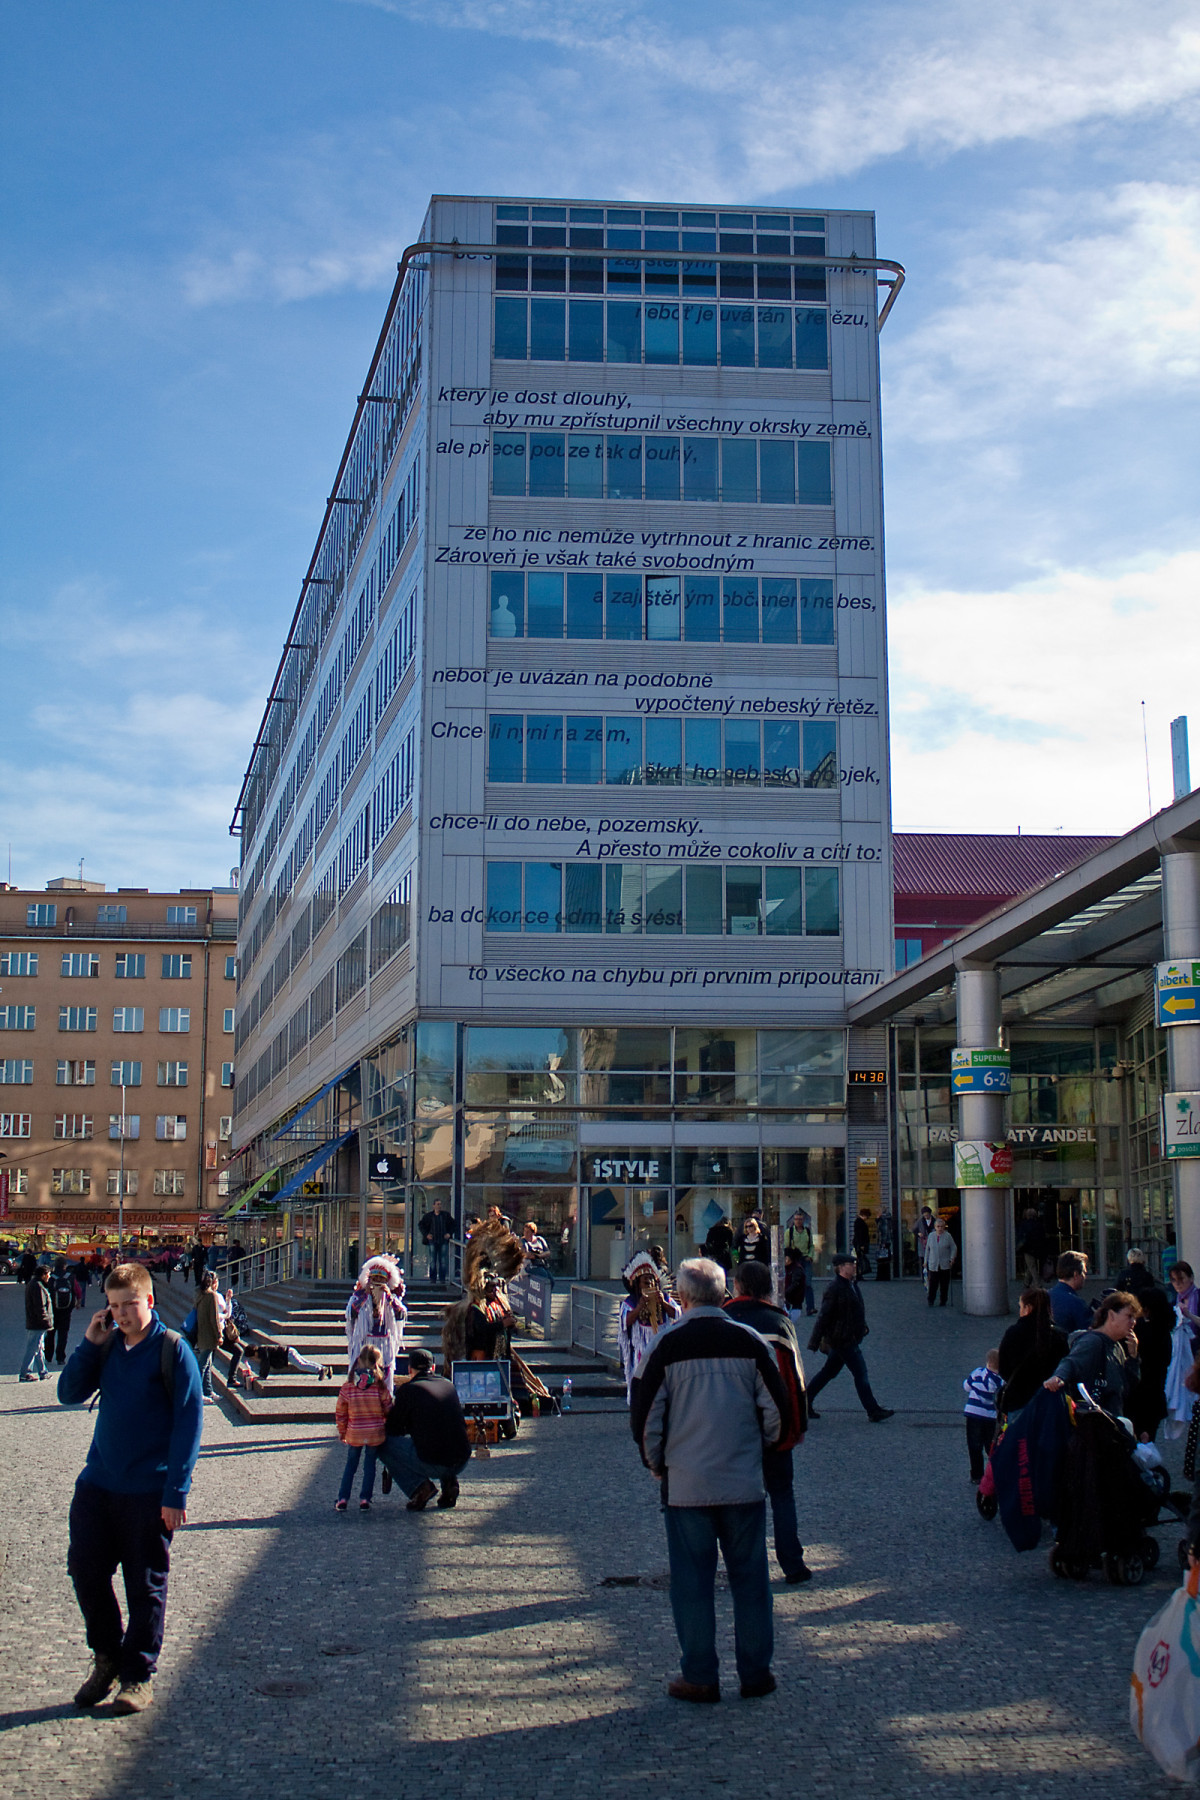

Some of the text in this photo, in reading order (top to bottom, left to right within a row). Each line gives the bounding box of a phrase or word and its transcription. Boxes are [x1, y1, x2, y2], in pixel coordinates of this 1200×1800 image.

[696, 306, 714, 324] je
[438, 387, 632, 410] který je dost dlouhý,
[483, 410, 872, 439] aby mu zpřístupnil všechny okrsky země,
[436, 438, 464, 455] ale
[468, 440, 525, 459] přece
[530, 444, 590, 462] pouze
[595, 444, 624, 460] tak
[464, 526, 876, 551] že ho nic nemůže vytrhnout z hranic země.
[435, 546, 755, 573] Zároveň je však také svobodným
[813, 593, 877, 613] nebes,
[432, 667, 713, 690] neboť je uvázán na podobně
[635, 694, 879, 717] vypočtený nebeský řetěz.
[506, 724, 549, 744] nyní
[553, 728, 577, 741] na
[584, 730, 631, 746] zem,
[693, 763, 718, 780] ho
[429, 813, 705, 836] chce-li do nebe, pozemský.
[576, 839, 882, 861] A přesto může cokoliv a cítí to:
[428, 906, 454, 923] ba
[468, 966, 488, 980] to
[495, 965, 565, 983] všecko
[572, 970, 597, 983] na
[603, 967, 665, 986] chybu
[670, 967, 698, 987] při
[702, 968, 772, 987] prvním
[1160, 973, 1189, 987] albert
[854, 1072, 885, 1083] 14 38
[1041, 1127, 1097, 1142] ANDĚL
[593, 1158, 659, 1178] iSTYLE
[14, 1212, 178, 1222] MUNDO MEXICANO RSTAURANT
